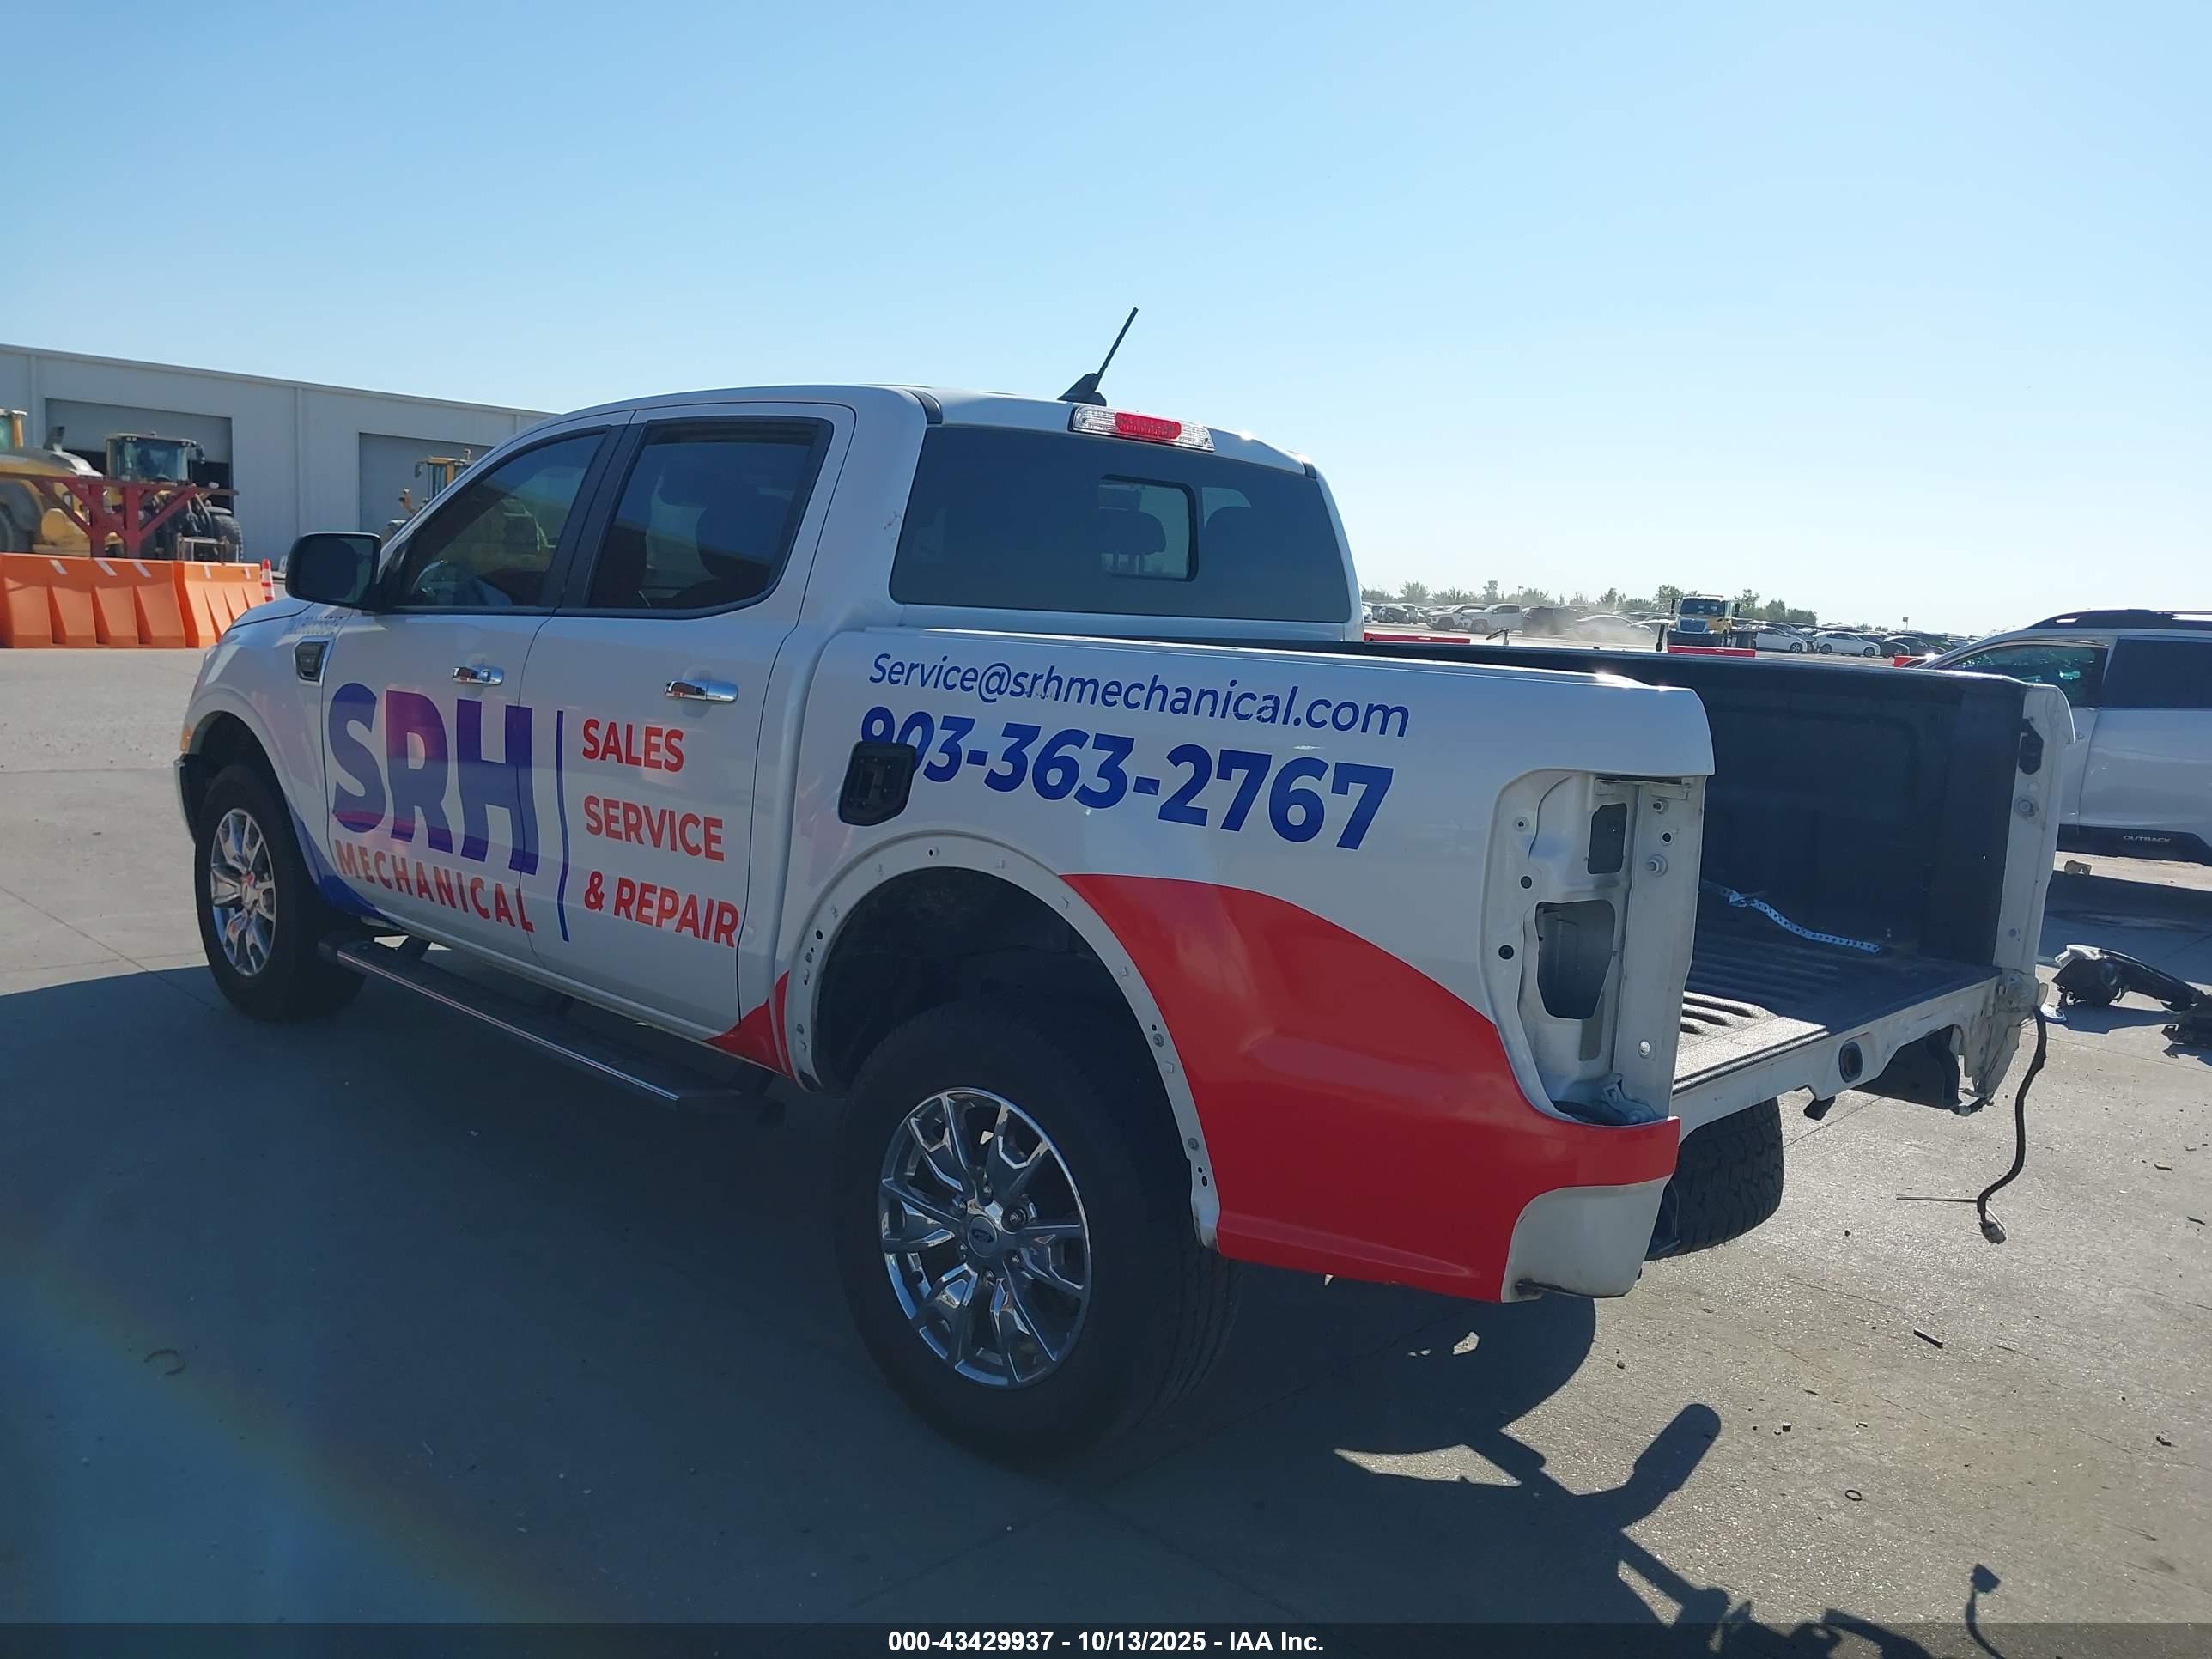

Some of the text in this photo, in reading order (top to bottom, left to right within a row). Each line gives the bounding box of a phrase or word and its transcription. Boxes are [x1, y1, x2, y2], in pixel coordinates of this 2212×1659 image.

[869, 653, 1409, 738] Service@srhmechanical.com
[328, 682, 539, 876] SRH
[582, 718, 684, 773] SALES
[583, 795, 725, 862] SERVICE
[2123, 835, 2172, 844] OUTBACK
[334, 839, 535, 933] MECHANICAL
[584, 871, 740, 949] & REPAIR
